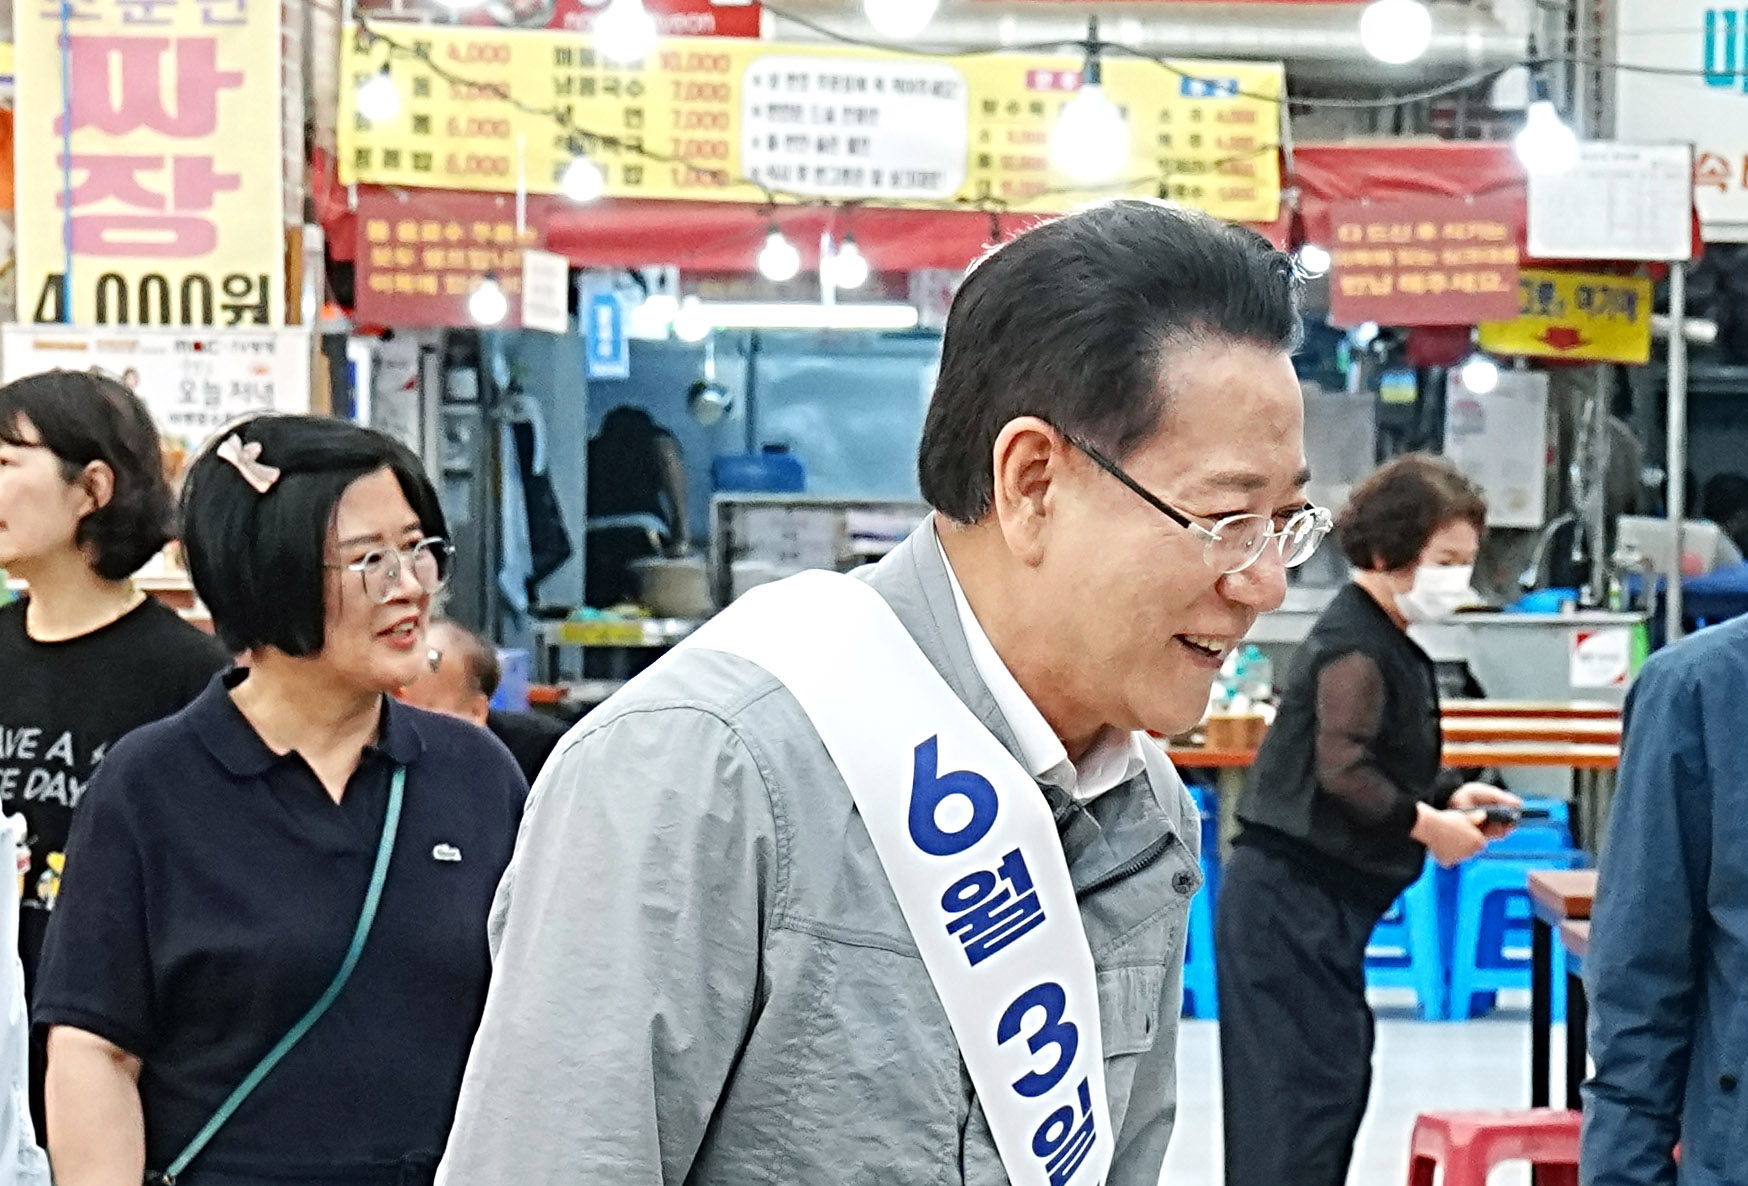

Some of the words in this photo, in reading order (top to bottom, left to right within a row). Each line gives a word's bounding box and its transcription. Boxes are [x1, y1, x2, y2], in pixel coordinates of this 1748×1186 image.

[53, 33, 244, 260] 짜장
[33, 272, 270, 324] 4000원
[0, 726, 43, 760] VE
[44, 730, 74, 767] A
[23, 768, 89, 809] DAY
[907, 733, 1047, 968] 6월
